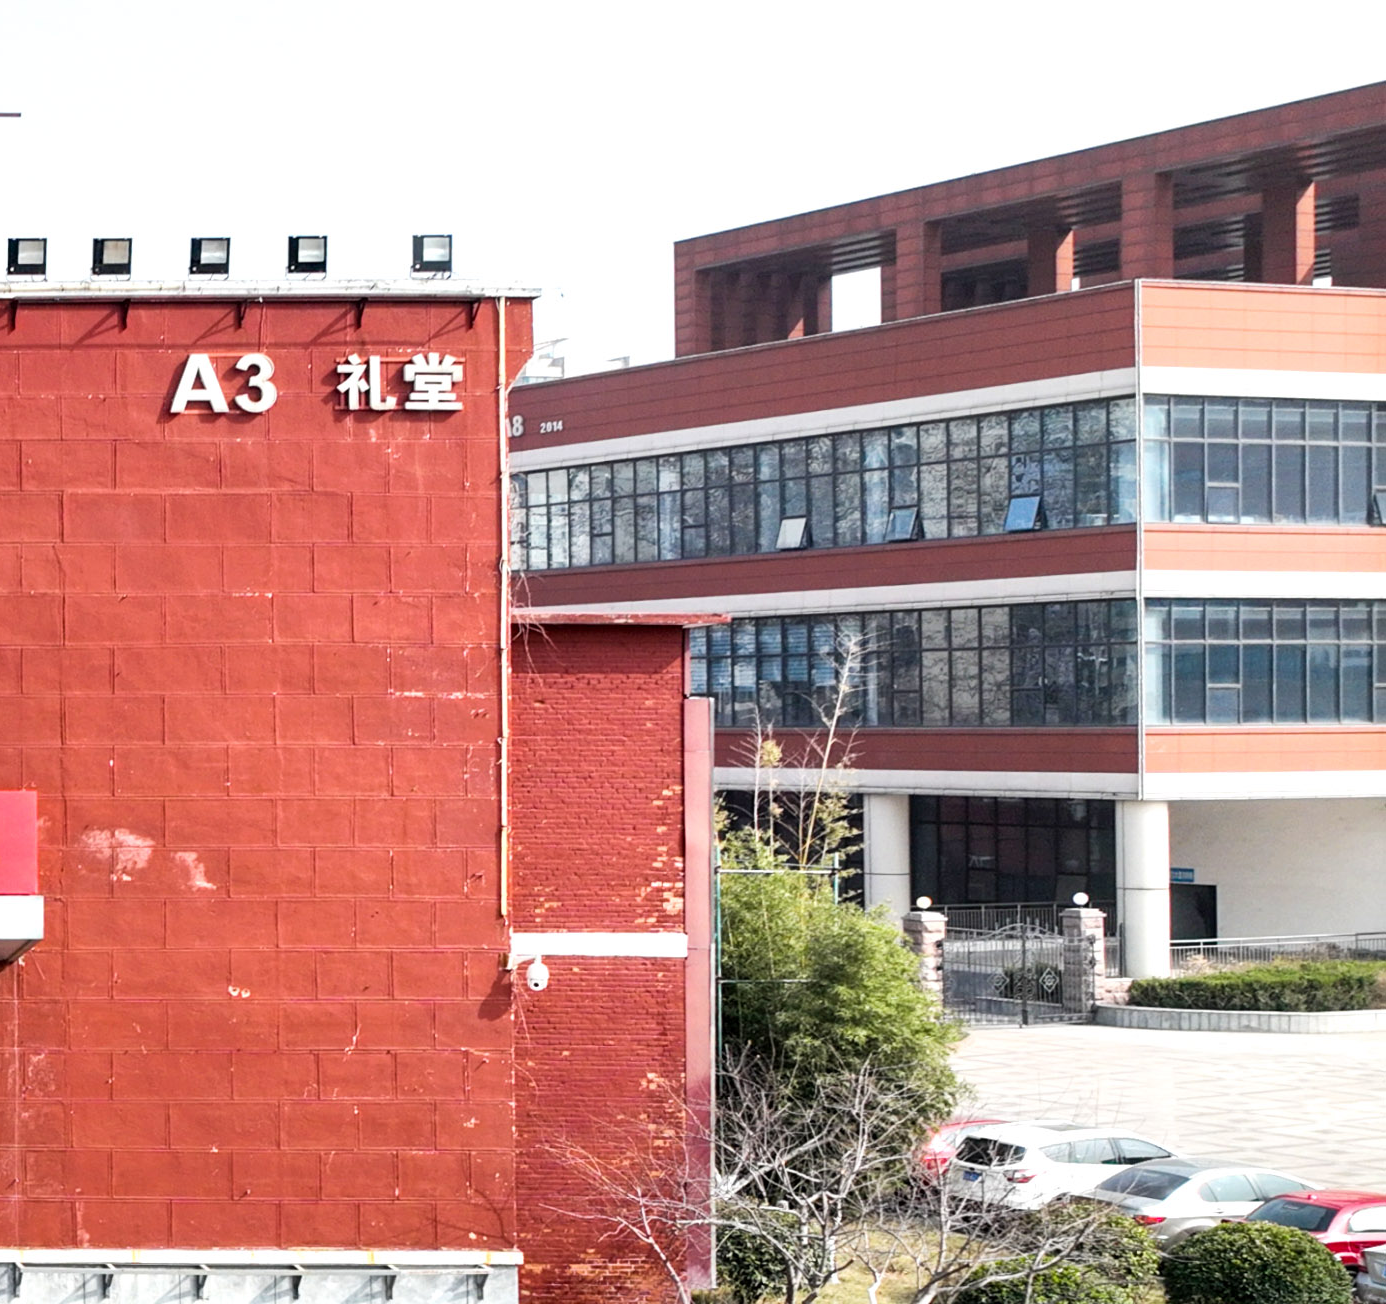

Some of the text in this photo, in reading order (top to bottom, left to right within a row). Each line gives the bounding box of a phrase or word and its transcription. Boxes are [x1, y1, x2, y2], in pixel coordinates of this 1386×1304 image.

[170, 352, 465, 415] A3 礼堂
[539, 420, 564, 434] 2014
